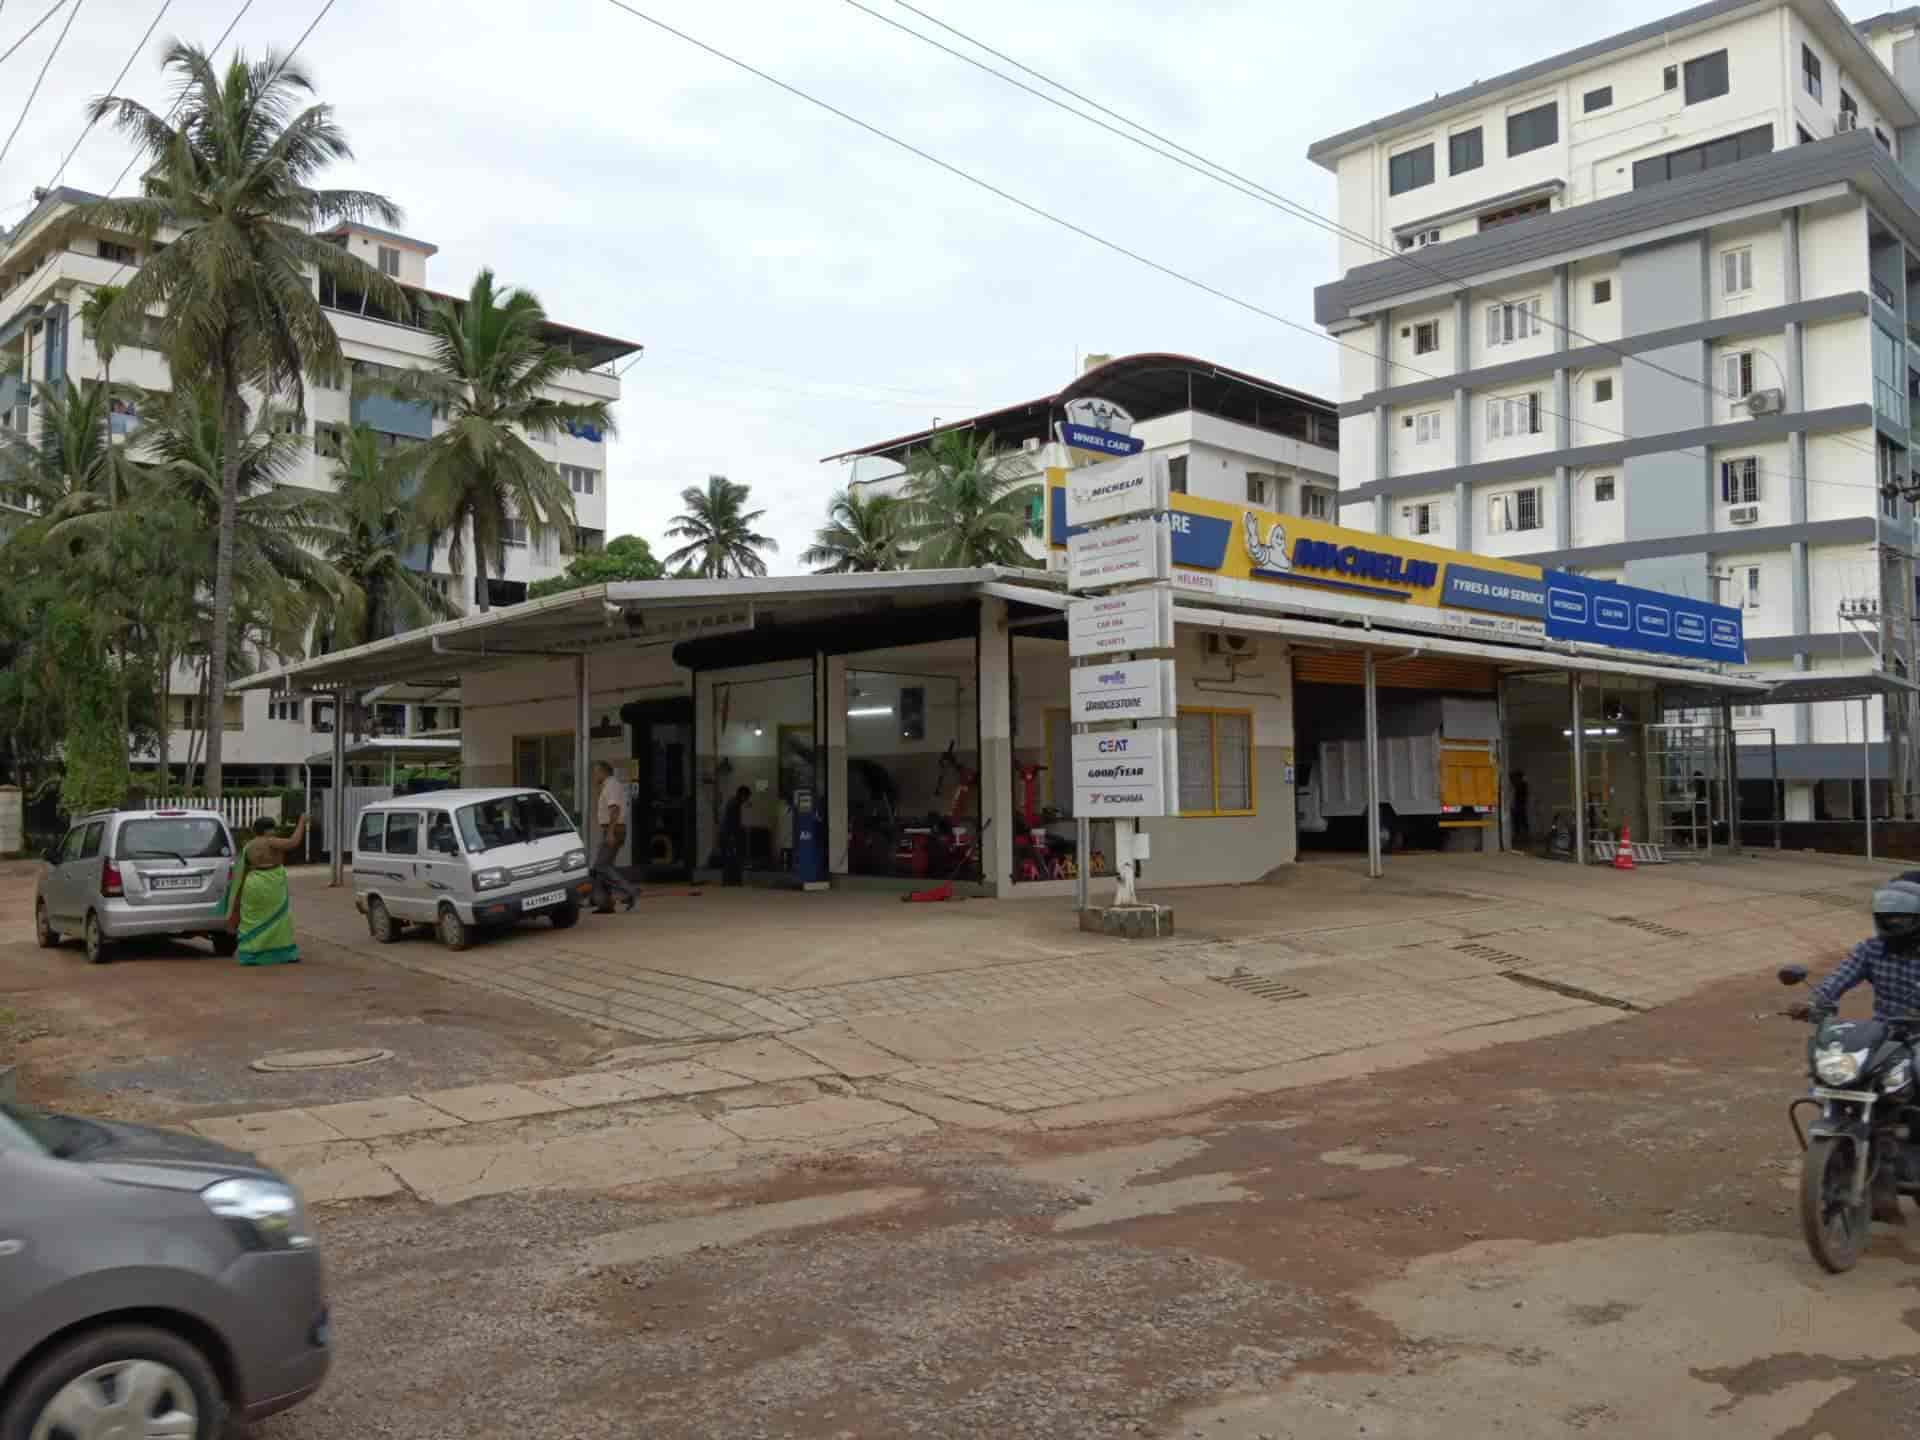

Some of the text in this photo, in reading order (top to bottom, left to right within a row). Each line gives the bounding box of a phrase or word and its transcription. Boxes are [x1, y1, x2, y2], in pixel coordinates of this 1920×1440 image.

[1073, 431, 1131, 452] WHEEL CARE
[1090, 476, 1144, 497] MICHELIN
[1293, 537, 1439, 589] MICHELIN
[1453, 577, 1482, 593] TYRES
[1491, 585, 1509, 599] CAR
[1510, 588, 1545, 605] SERVICE
[1085, 696, 1141, 711] BRIDGESTONE
[1098, 739, 1128, 753] CEAT
[1088, 765, 1144, 781] GOODYEAR
